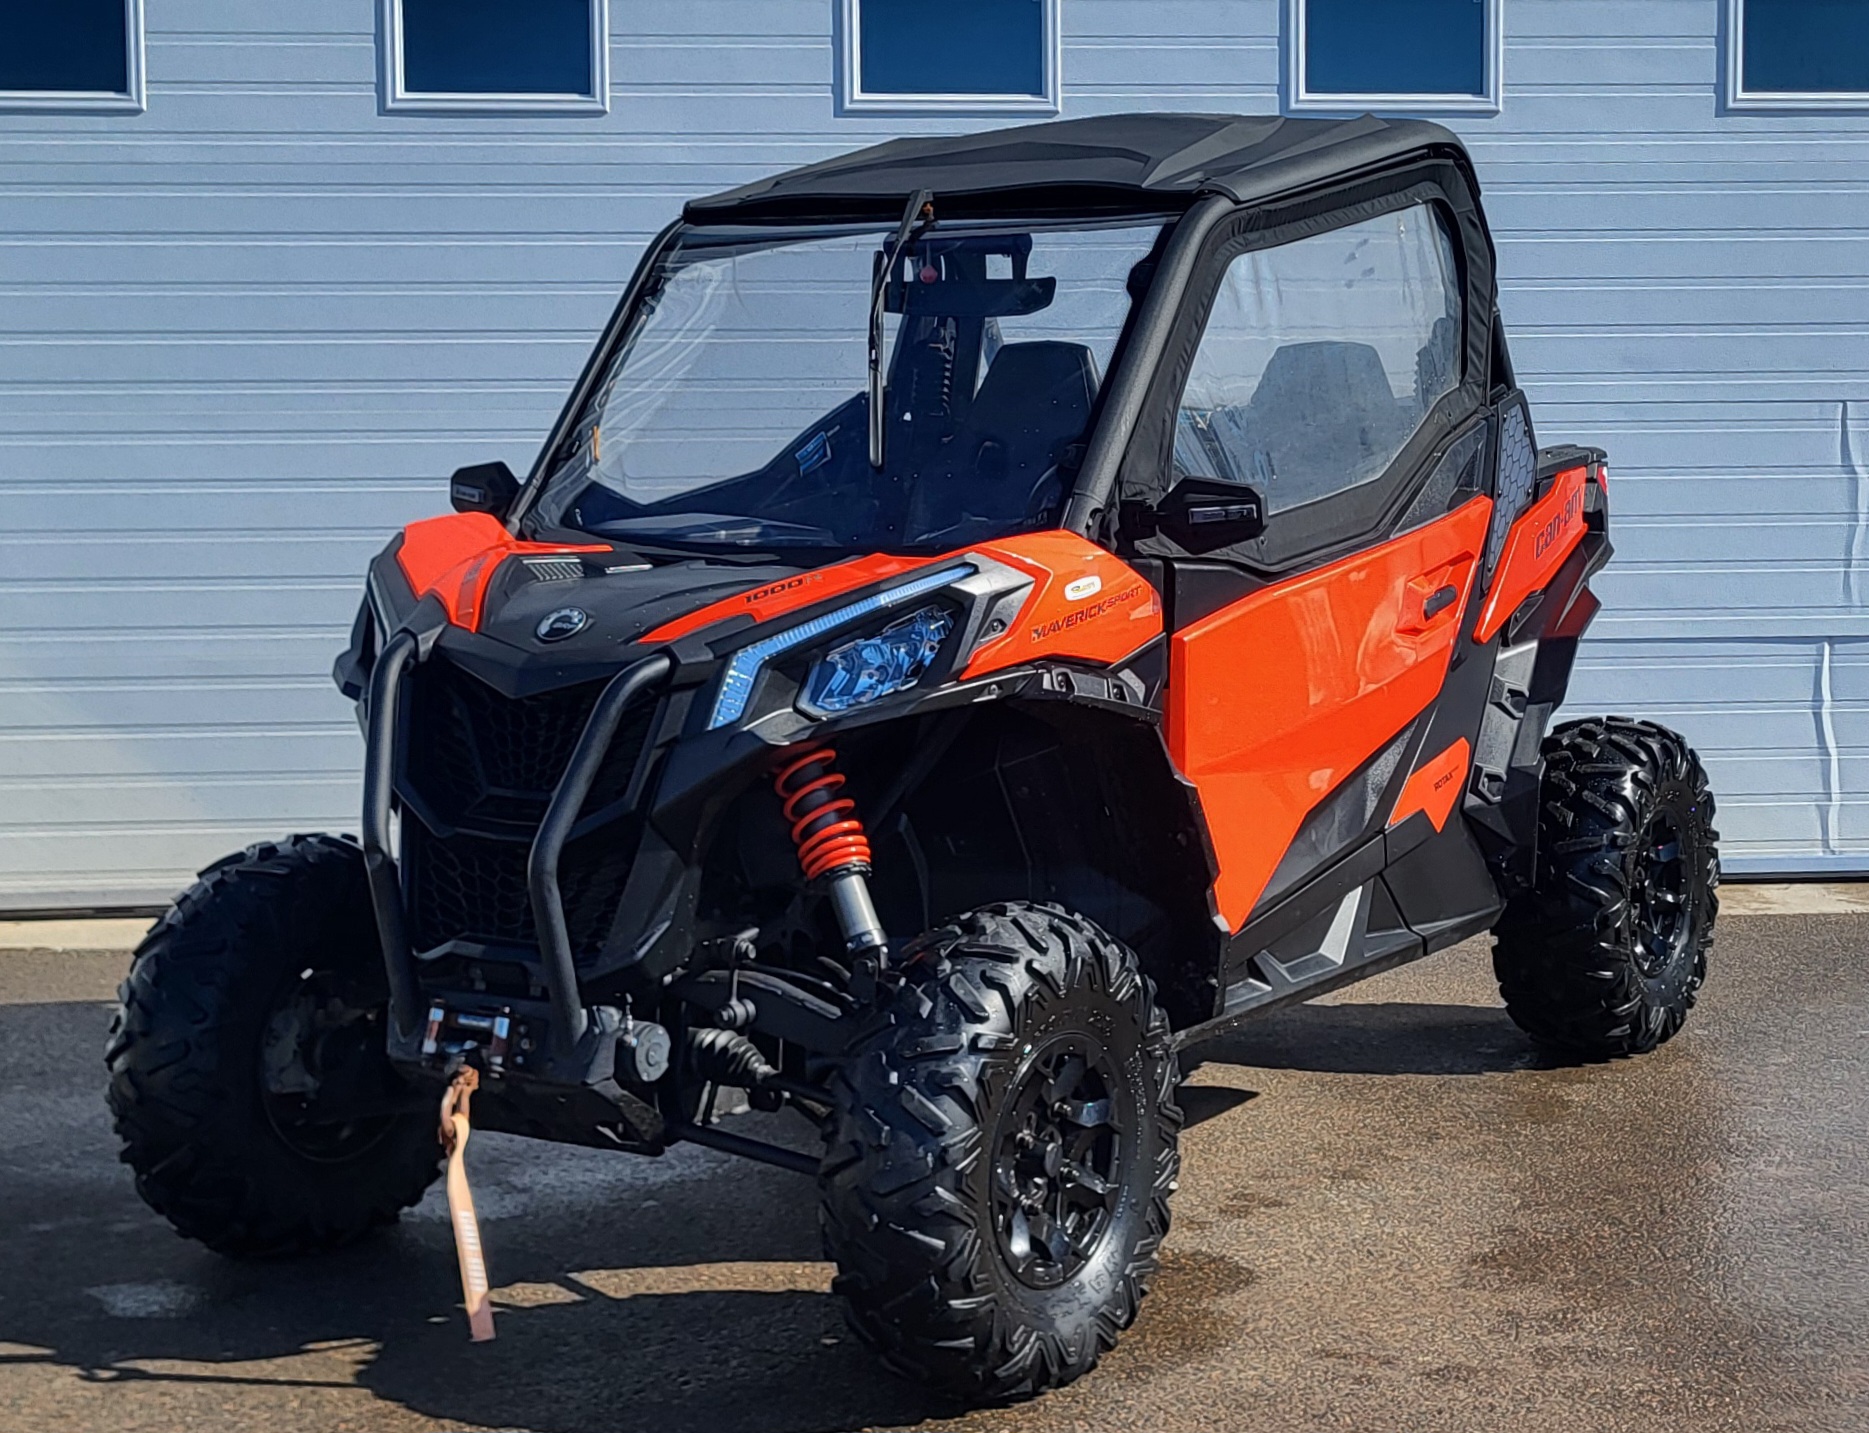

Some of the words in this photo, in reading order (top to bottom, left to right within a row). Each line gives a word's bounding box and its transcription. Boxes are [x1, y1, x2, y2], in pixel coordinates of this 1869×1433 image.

[745, 578, 804, 603] 1000
[1032, 600, 1107, 642] MAVERICK
[1105, 584, 1143, 609] SPORT
